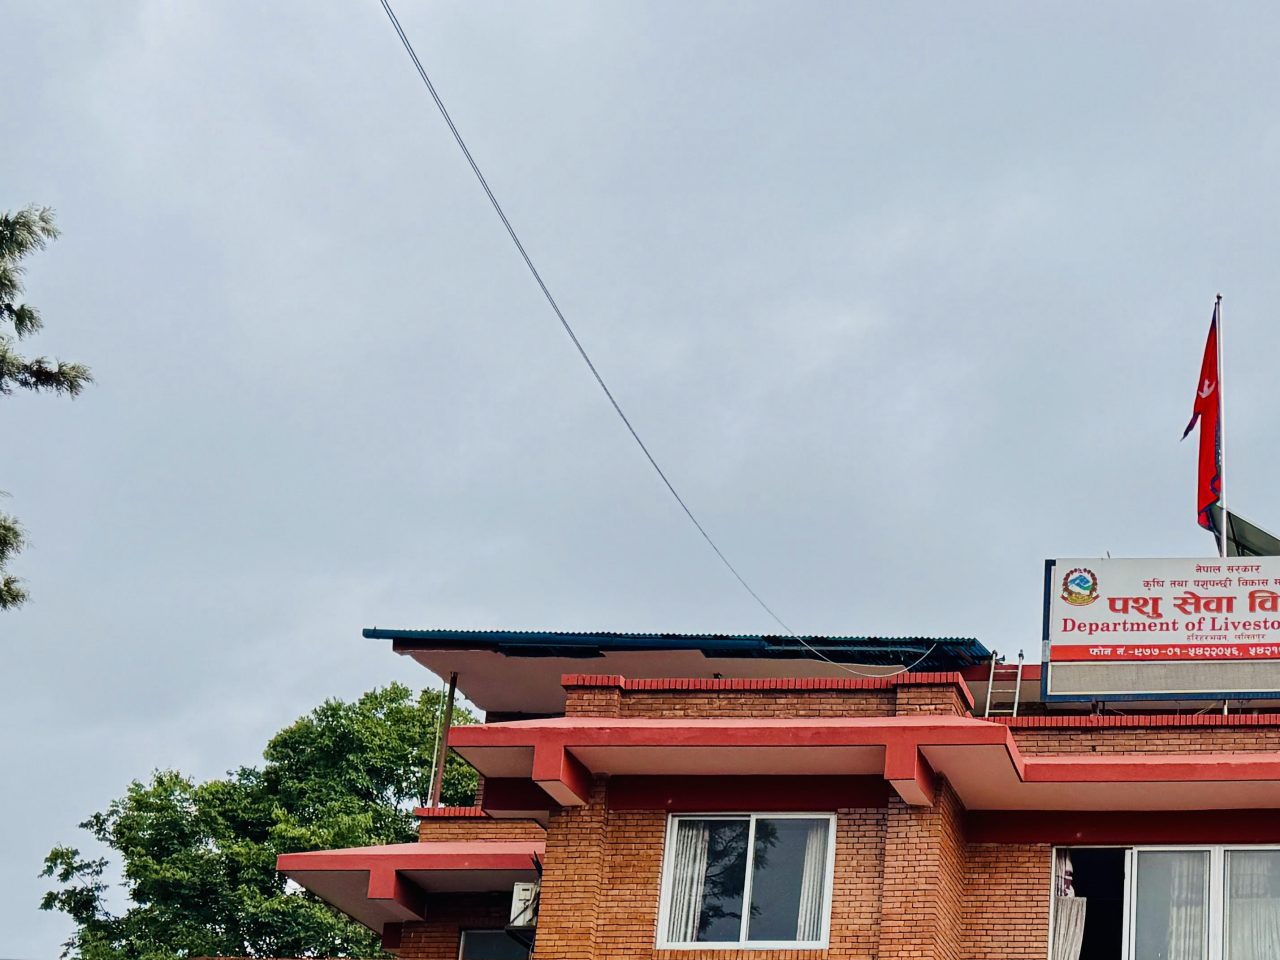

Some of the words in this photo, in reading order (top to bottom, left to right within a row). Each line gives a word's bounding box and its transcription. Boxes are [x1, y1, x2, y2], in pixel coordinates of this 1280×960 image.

[1195, 564, 1221, 573] नेपाल
[1227, 565, 1262, 574] सरकार
[1238, 577, 1268, 587] विकास
[1107, 596, 1163, 620] पशु
[1173, 591, 1237, 616] सेवा
[1061, 618, 1179, 636] Department
[1185, 617, 1206, 632] of
